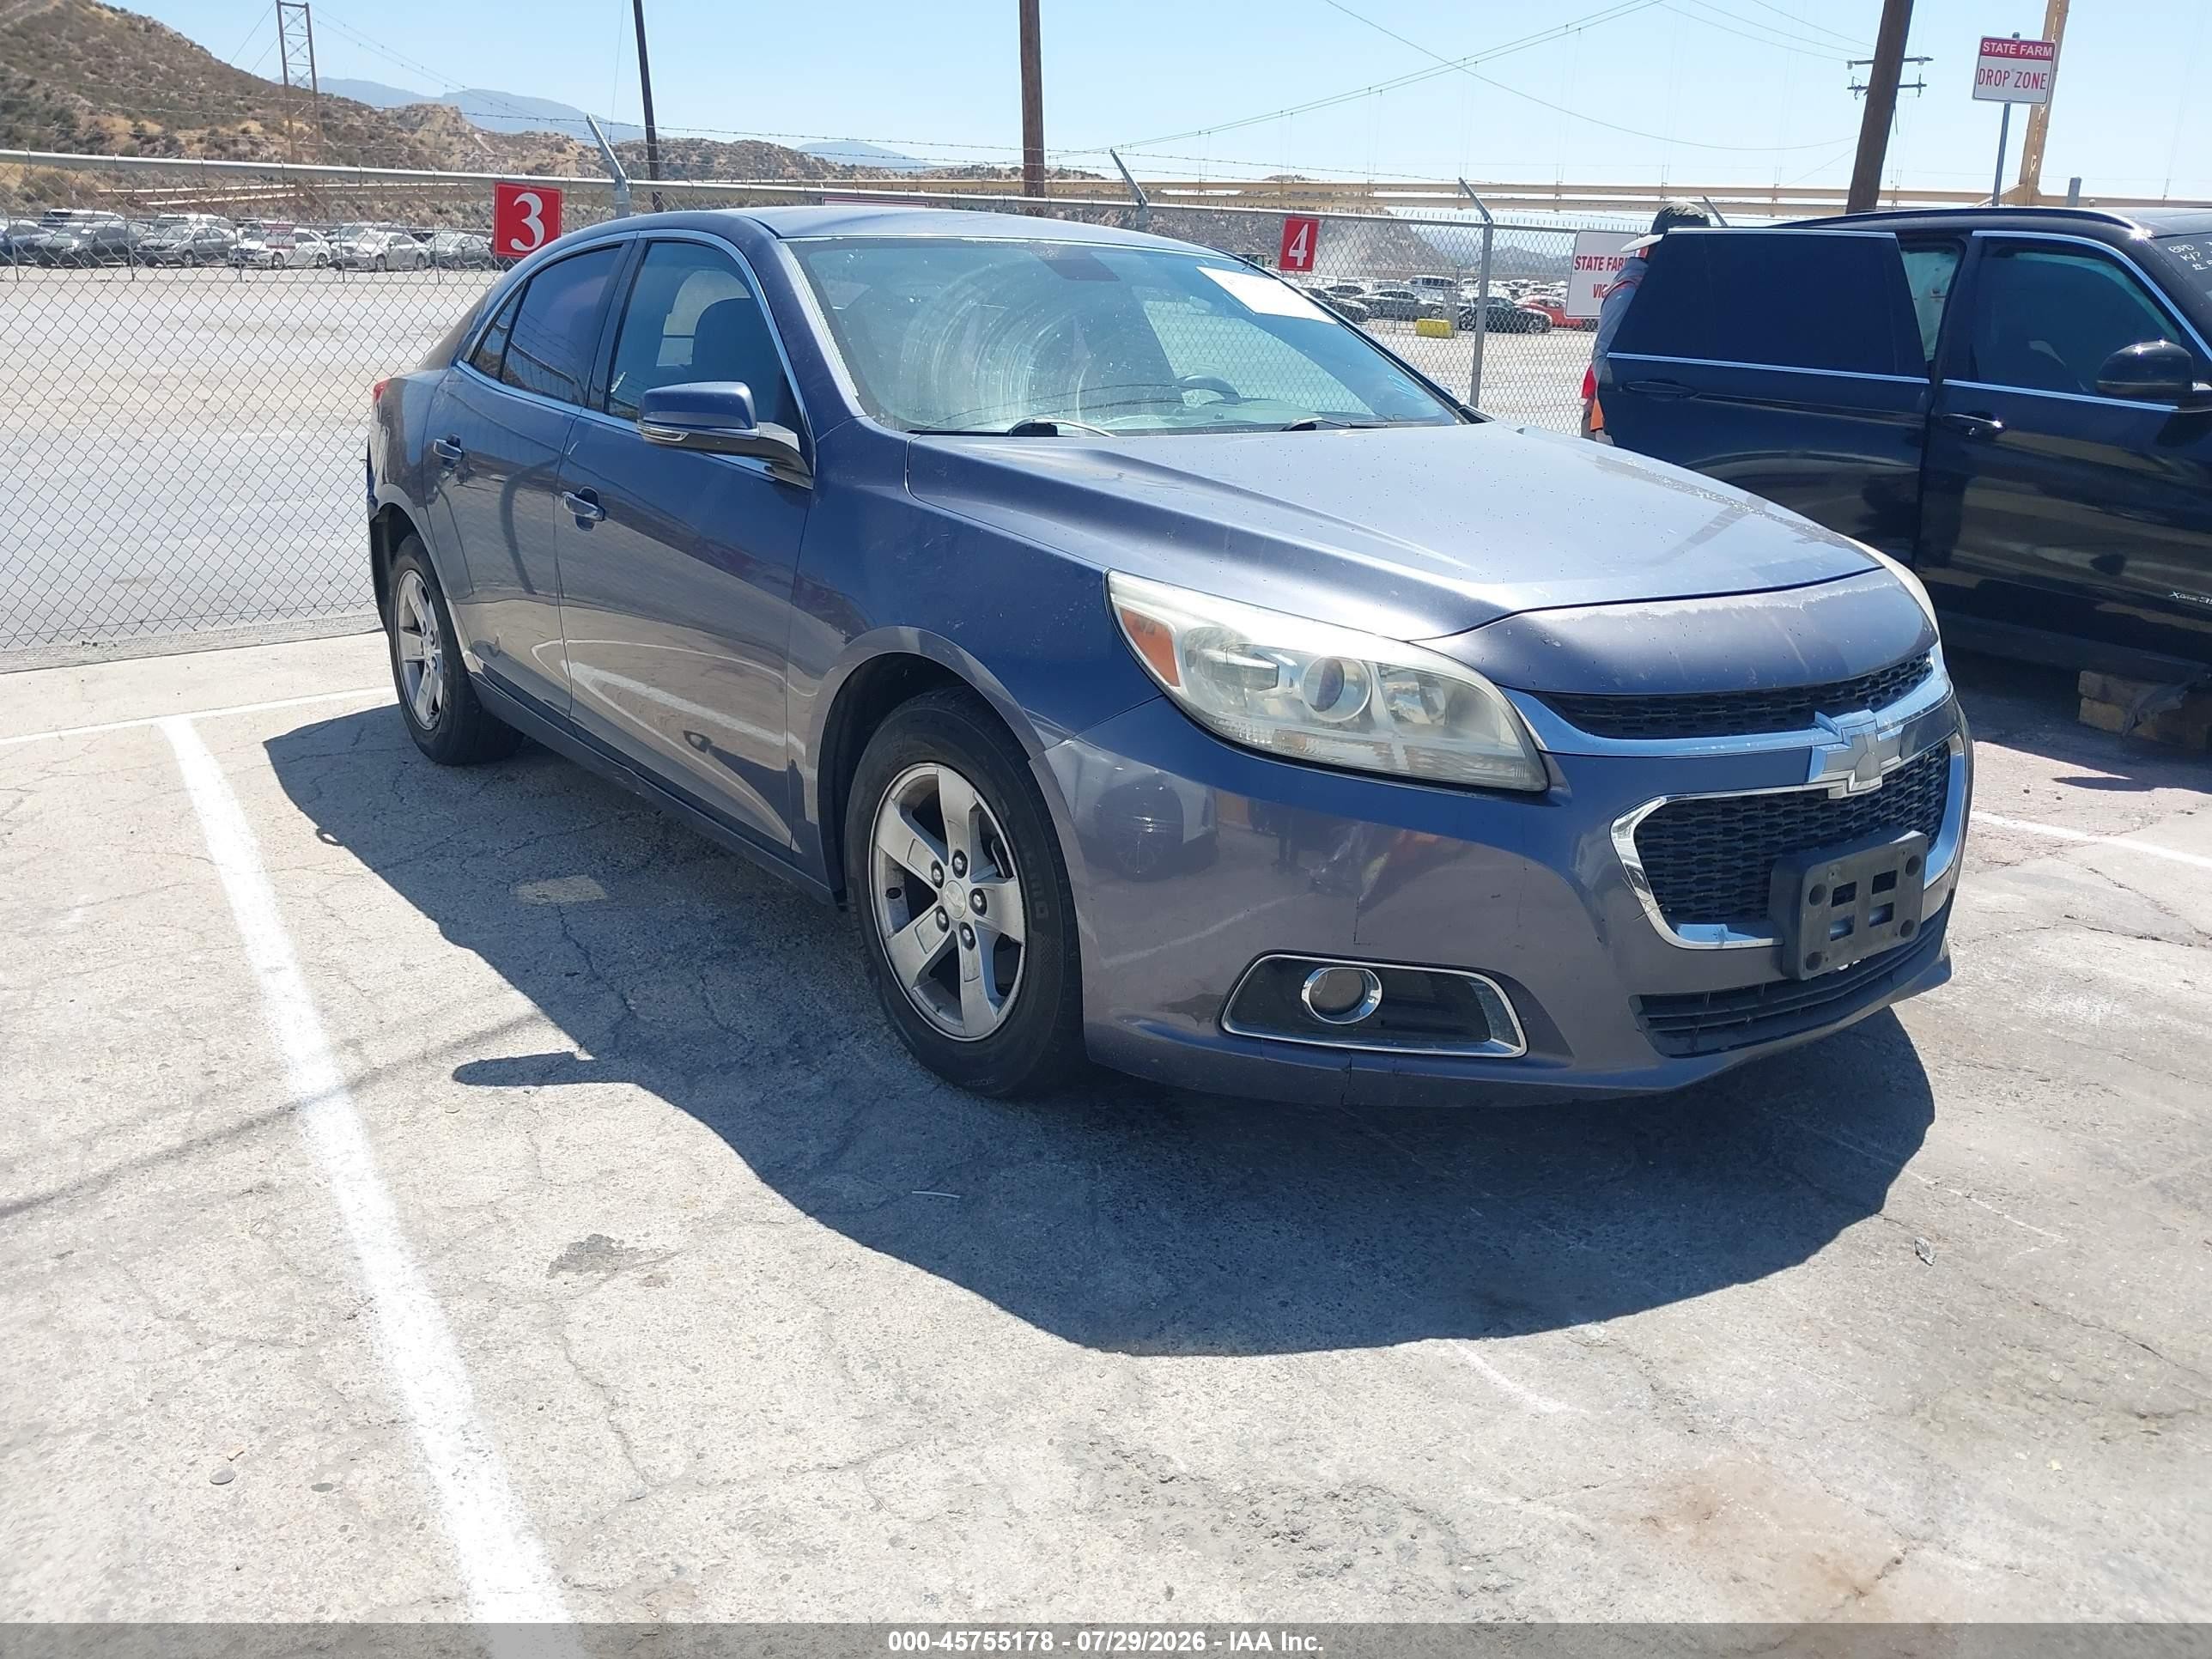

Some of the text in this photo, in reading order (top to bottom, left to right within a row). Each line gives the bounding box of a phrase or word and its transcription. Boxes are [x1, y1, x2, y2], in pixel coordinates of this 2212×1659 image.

[1983, 41, 2052, 57] STATE FARM
[1978, 69, 2047, 90] DROP ZONE
[510, 191, 545, 252] 3
[1289, 223, 1309, 266] 4
[1574, 256, 1628, 271] STATE FAR
